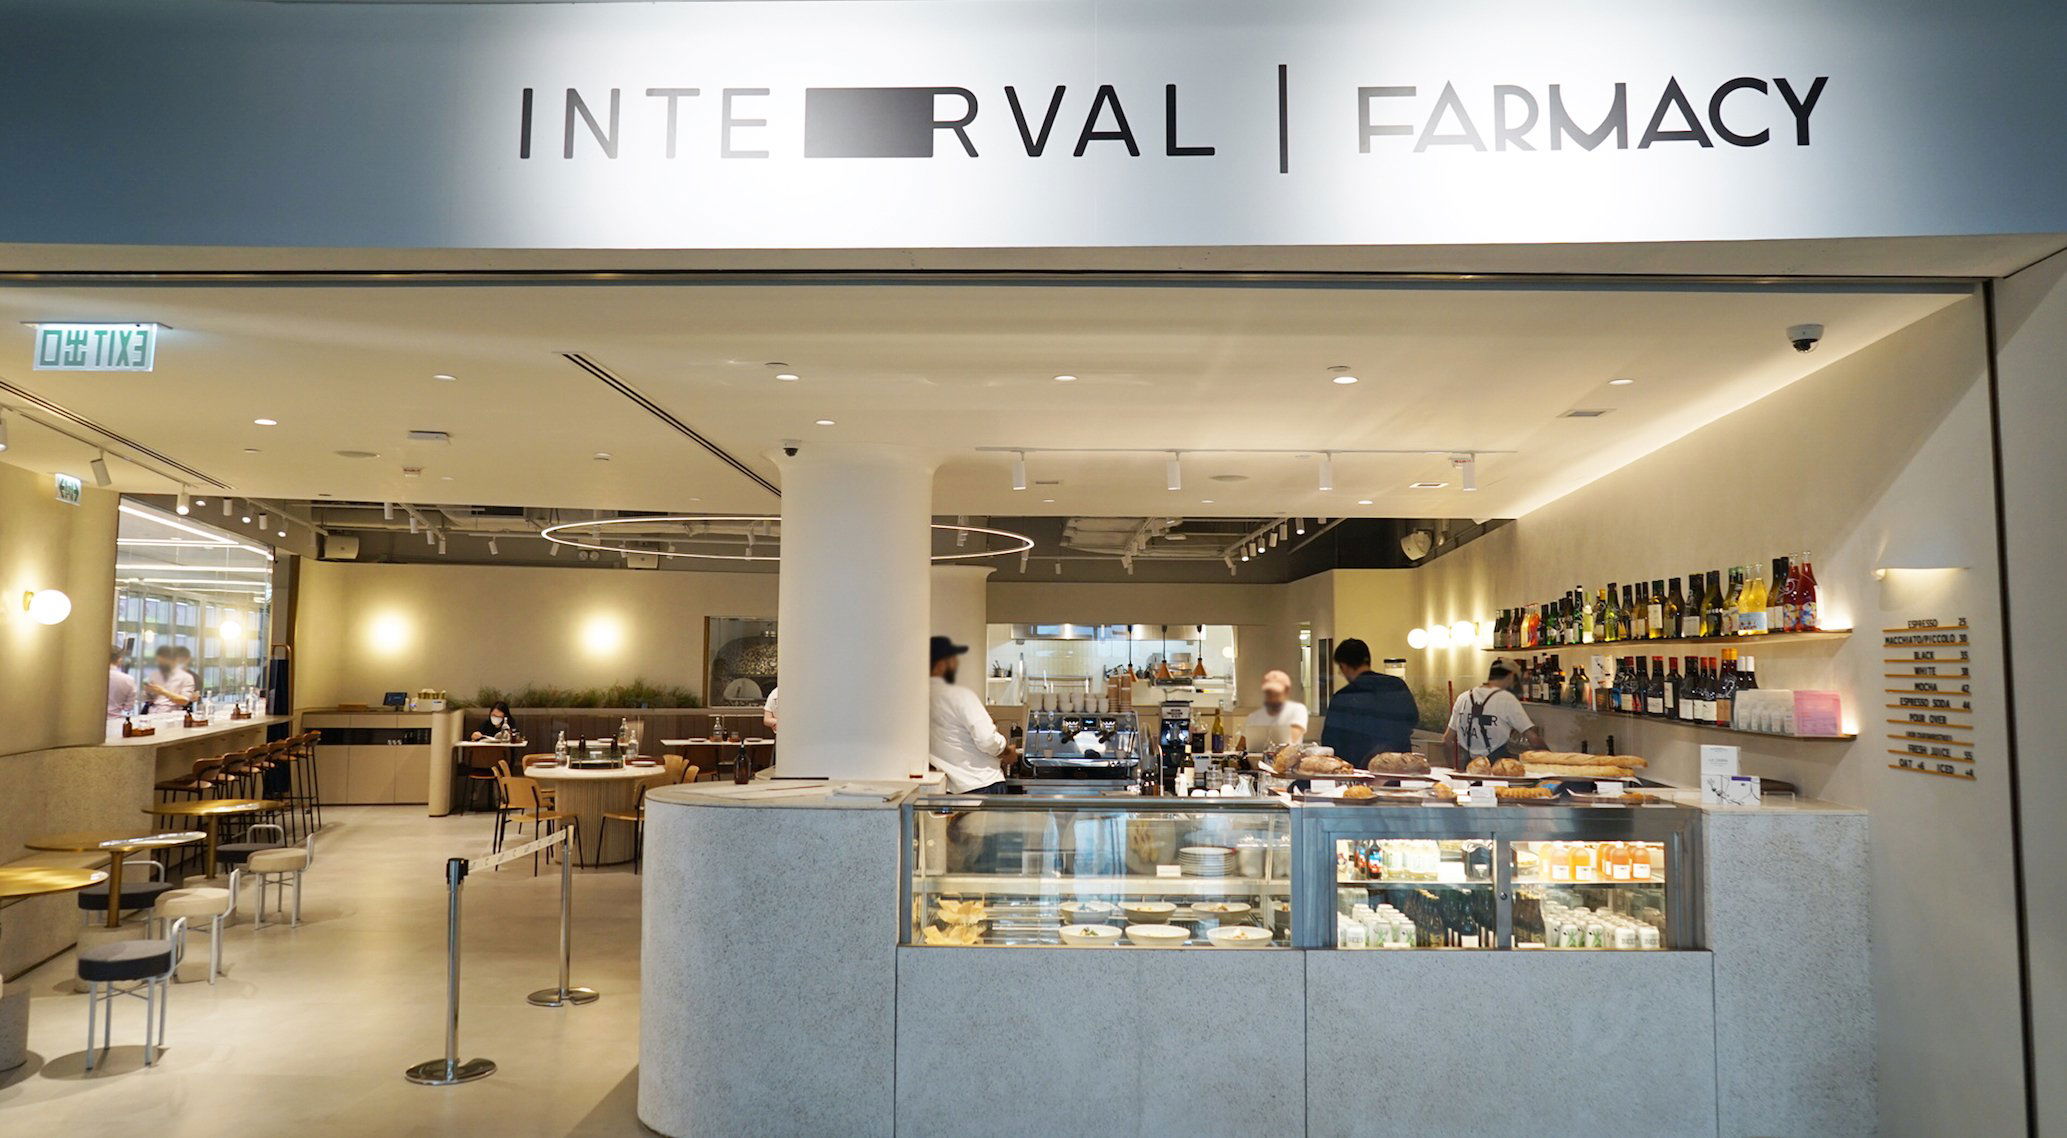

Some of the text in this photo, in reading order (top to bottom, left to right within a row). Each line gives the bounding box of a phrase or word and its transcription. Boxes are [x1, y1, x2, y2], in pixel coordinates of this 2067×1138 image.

[1357, 76, 1830, 154] FARMACY
[1907, 619, 1938, 629] ESPRESSO
[1885, 633, 1956, 645] MACCHIATO/PICCOLO
[1914, 651, 1935, 660] BLACK
[1914, 666, 1936, 676] WHITE
[1914, 682, 1938, 692] MOCHA
[1900, 697, 1929, 708] ESPRESSO
[1932, 699, 1951, 709] SODA
[1909, 713, 1947, 725] POUR OVER
[1908, 744, 1928, 755] FRESH
[1931, 747, 1951, 758] JUICE
[1899, 758, 1913, 769] OAT
[1937, 764, 1954, 775] ICED
